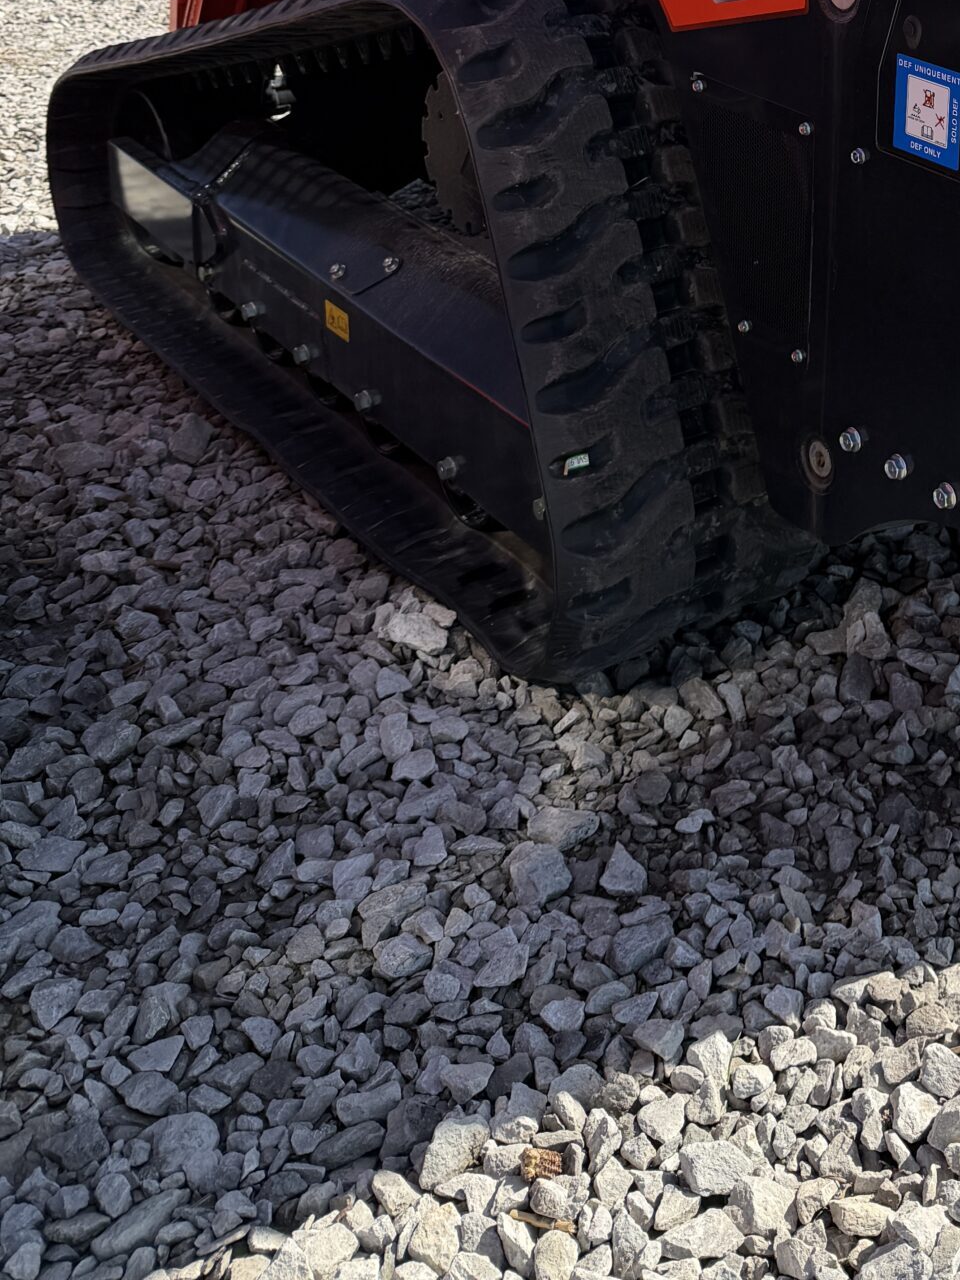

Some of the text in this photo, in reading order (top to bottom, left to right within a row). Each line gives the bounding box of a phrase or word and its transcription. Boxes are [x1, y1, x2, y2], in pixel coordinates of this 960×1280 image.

[898, 58, 912, 70] DEF
[950, 98, 959, 144] SOLO DEF
[909, 140, 923, 151] DEF
[923, 147, 942, 159] ONLY
